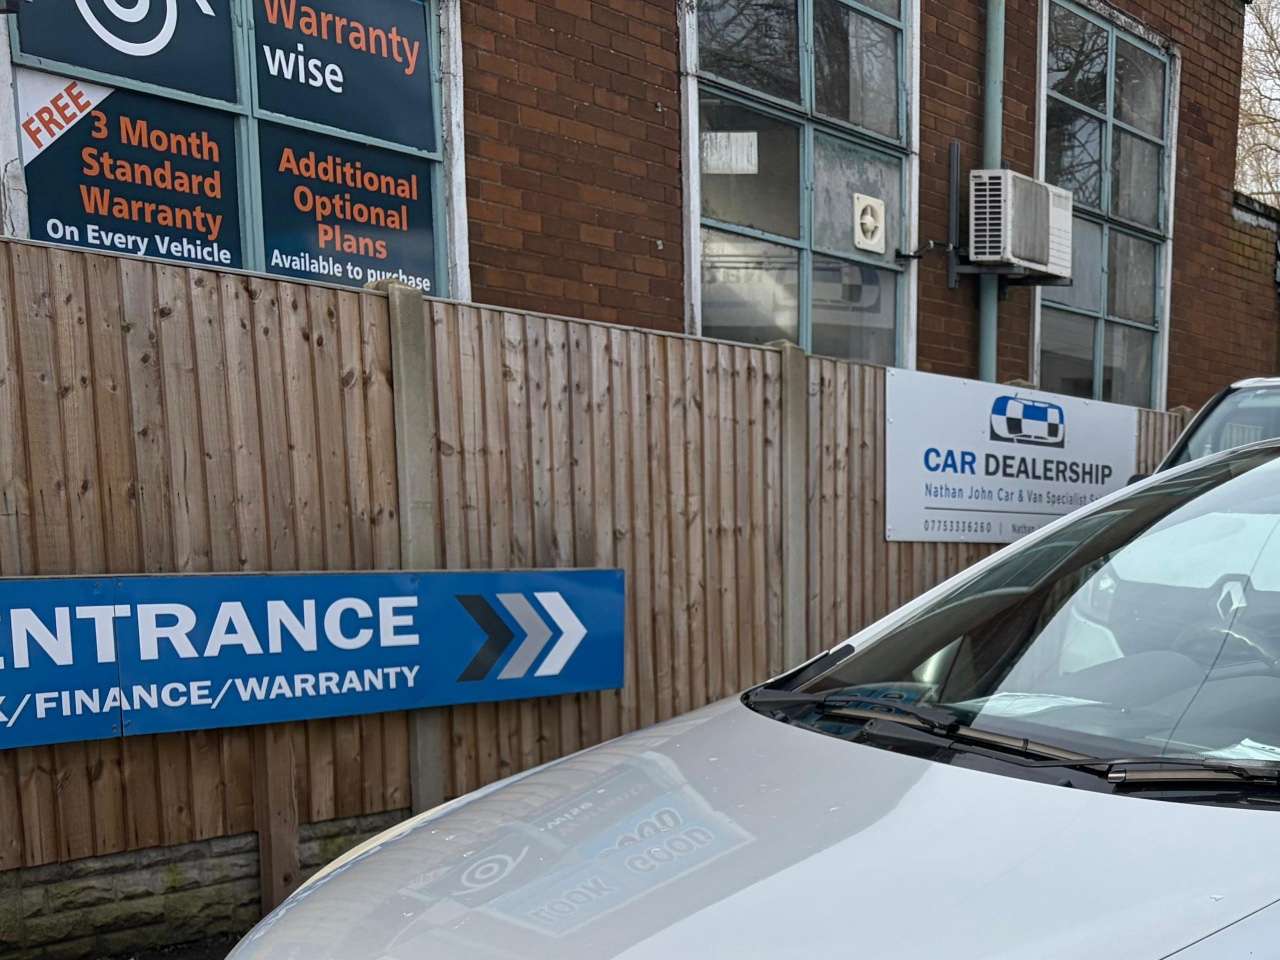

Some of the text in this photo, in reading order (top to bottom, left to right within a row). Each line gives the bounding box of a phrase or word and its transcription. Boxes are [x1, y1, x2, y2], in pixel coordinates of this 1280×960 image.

[263, 0, 420, 76] Warranty
[262, 43, 344, 93] wise
[21, 80, 92, 149] FREE
[90, 110, 220, 163] 3 Month
[81, 146, 222, 199] Standard
[278, 147, 418, 200] Additional
[79, 184, 223, 241] Warranty
[293, 185, 408, 231] Optional
[46, 218, 232, 264] On Every Vehicle
[270, 249, 342, 277] Available
[346, 262, 363, 280] to
[318, 223, 388, 260] Plans
[923, 447, 1113, 486] CAR DEALERSHIP
[924, 483, 964, 499] Nathan
[968, 484, 993, 501] John
[997, 487, 1015, 502] Car
[1018, 489, 1024, 502] &
[1027, 490, 1044, 504] Van
[0, 595, 420, 670] NTRANCE
